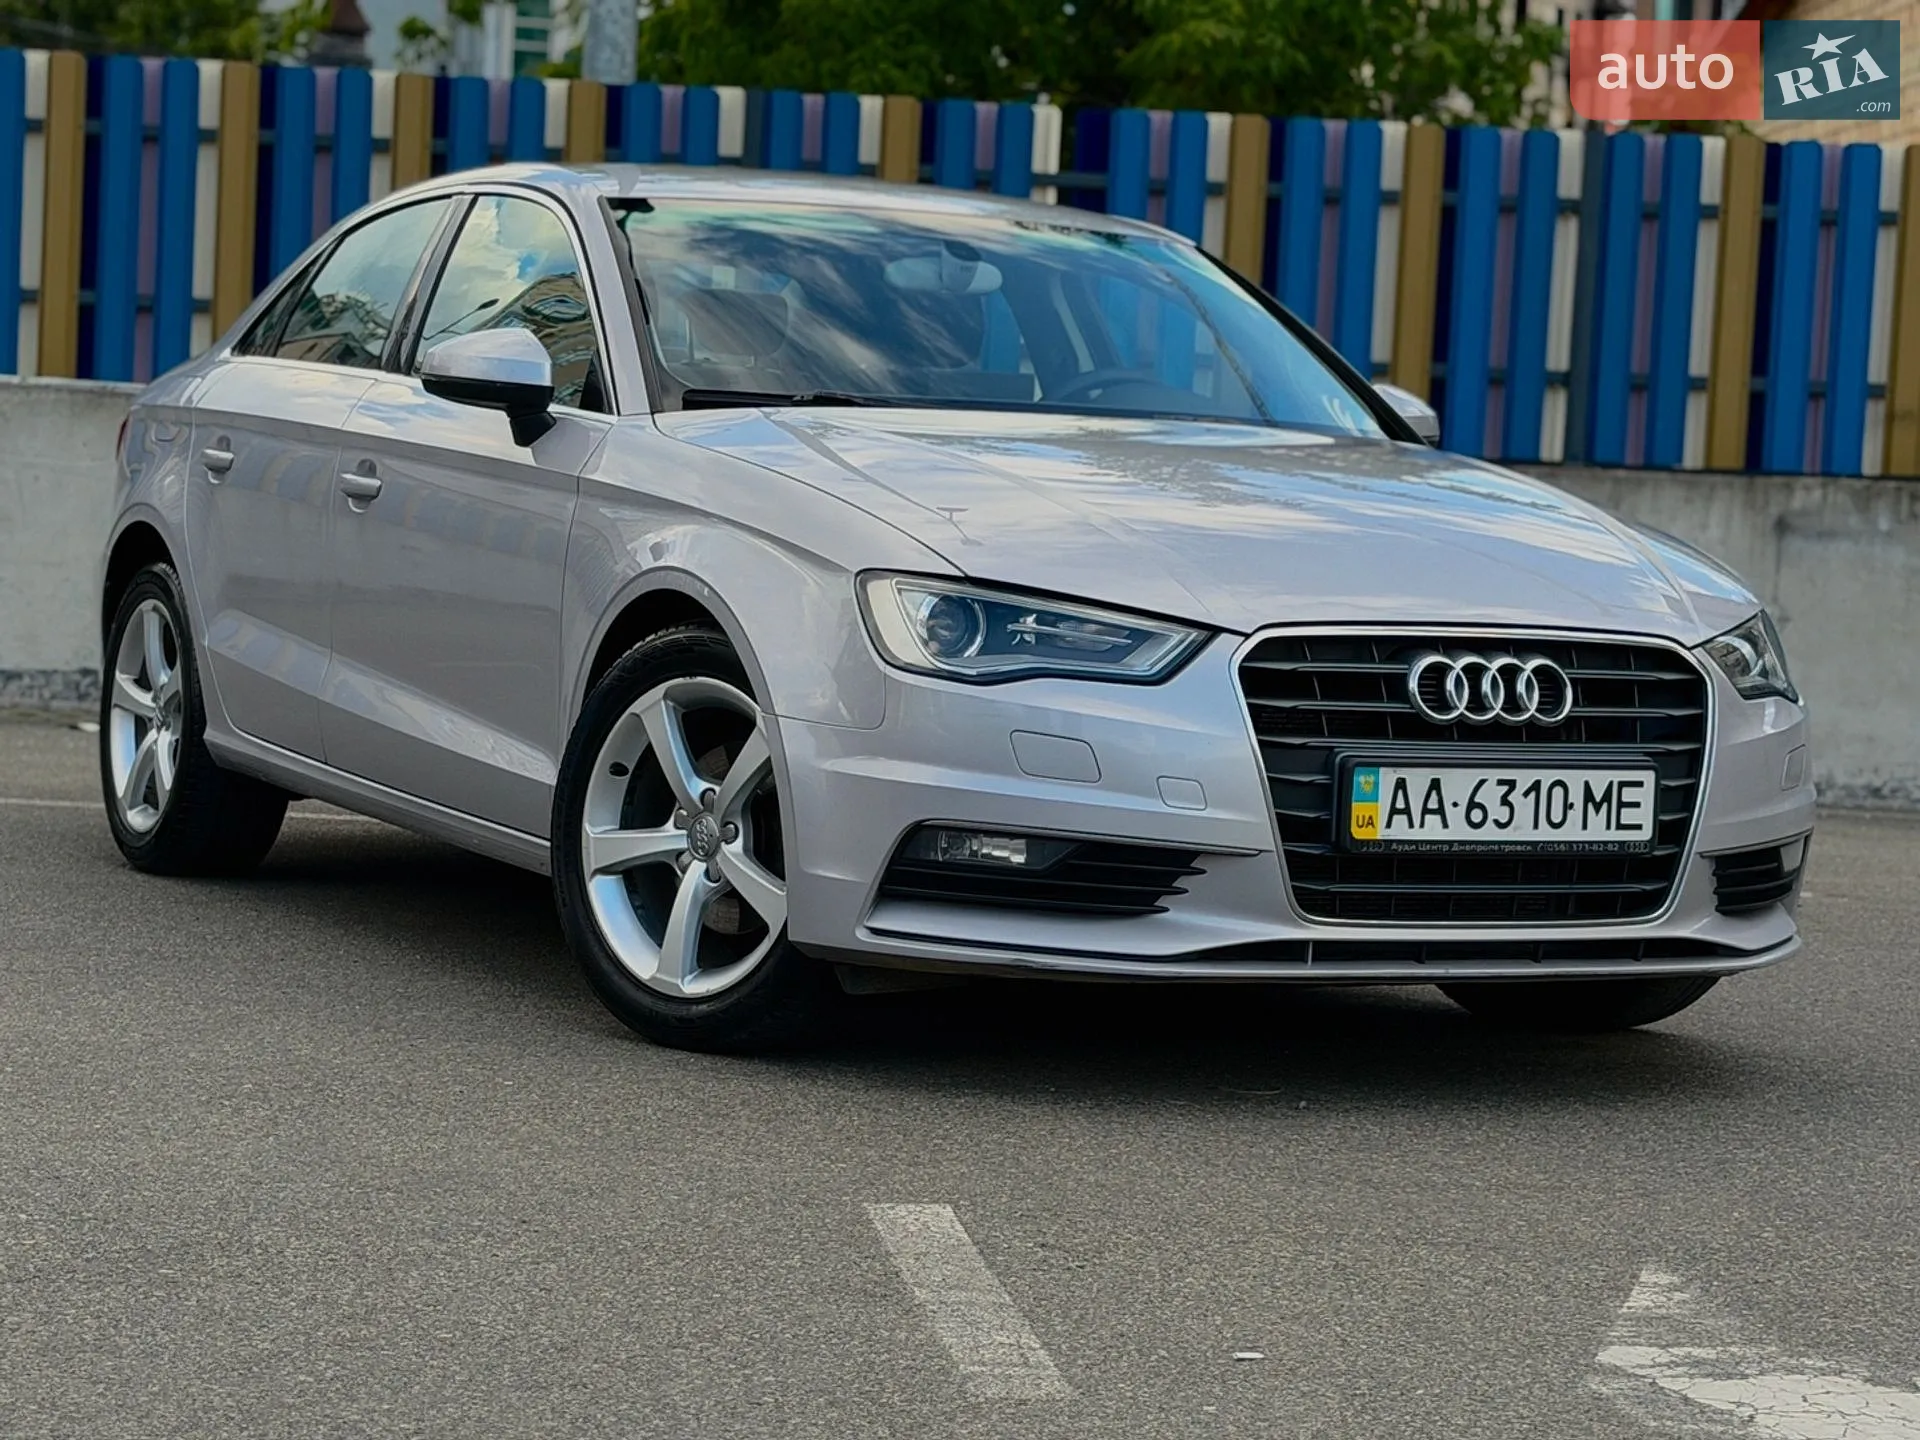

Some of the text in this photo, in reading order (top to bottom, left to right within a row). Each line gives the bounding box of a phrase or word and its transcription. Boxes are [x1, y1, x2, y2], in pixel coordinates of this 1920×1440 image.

[1384, 776, 1645, 832] AA 6310 ME
[1355, 814, 1375, 829] UA
[1418, 842, 1450, 852] Центр
